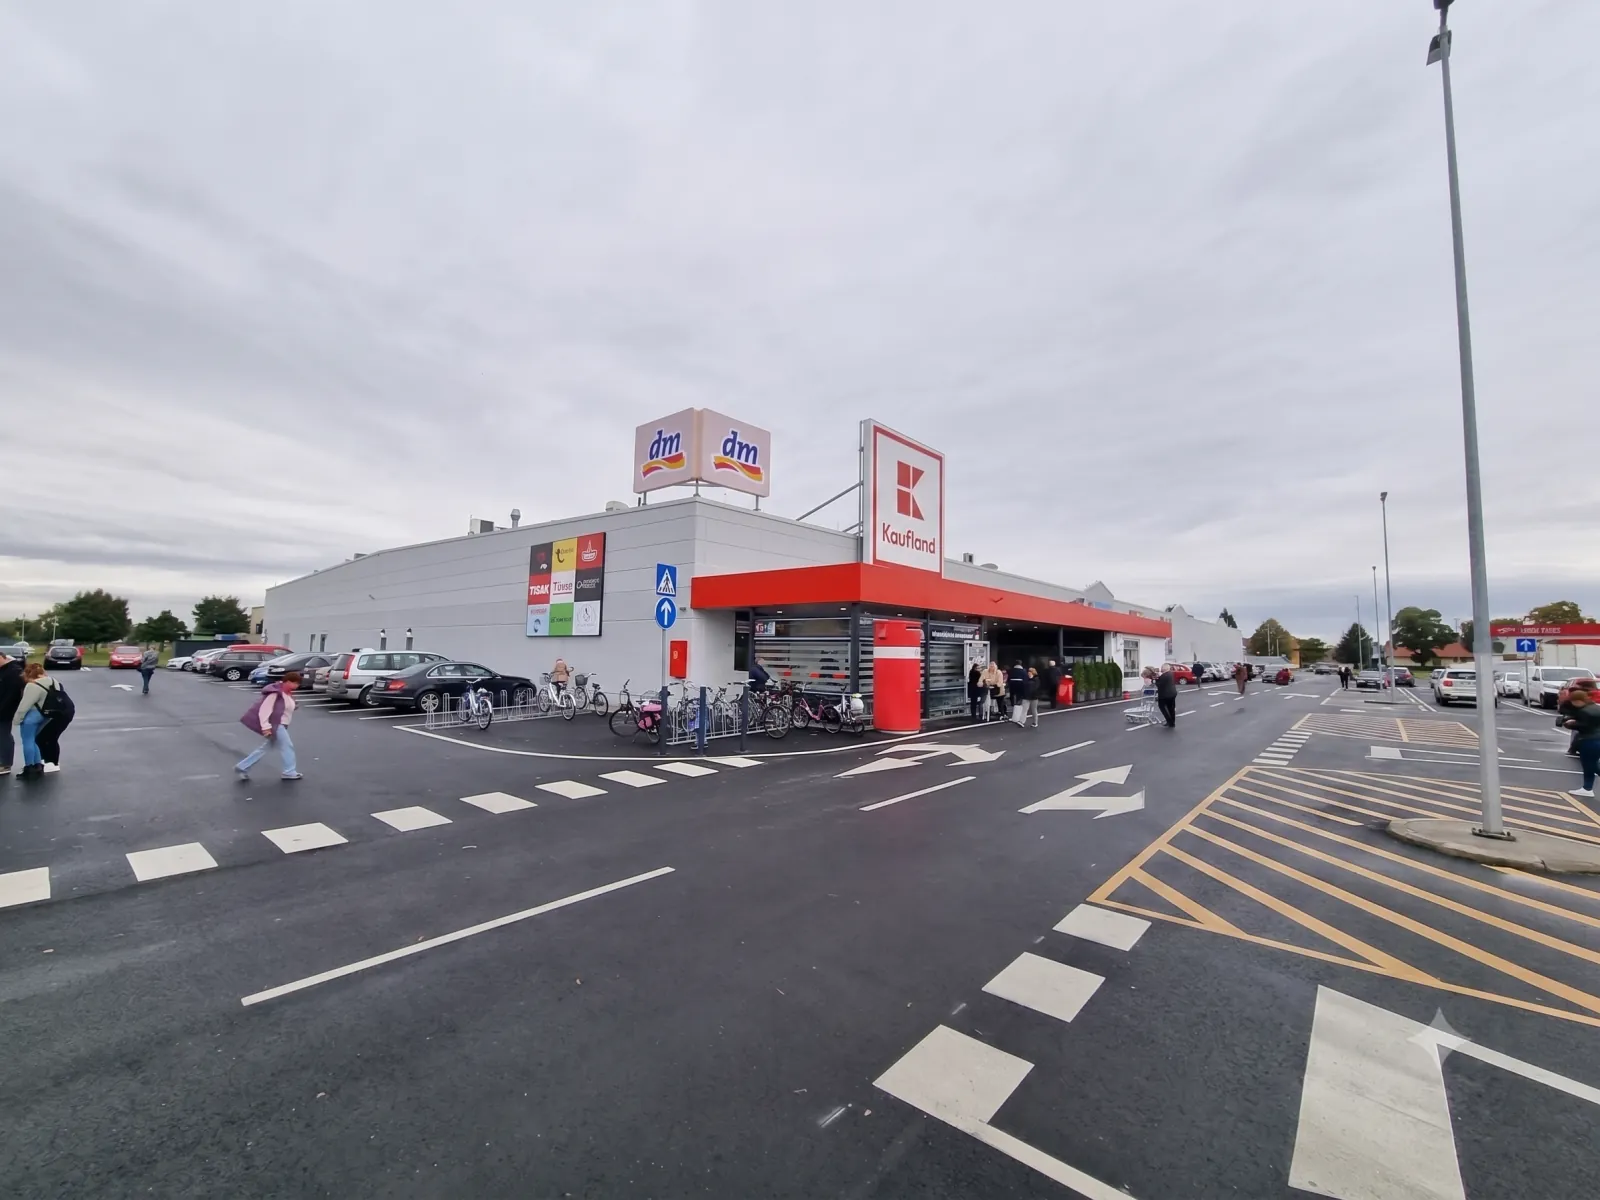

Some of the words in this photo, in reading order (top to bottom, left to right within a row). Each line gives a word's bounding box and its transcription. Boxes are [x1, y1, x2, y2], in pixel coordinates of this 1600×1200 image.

[649, 429, 681, 460] dm
[722, 430, 758, 465] dm
[882, 522, 936, 554] Kaufland
[530, 584, 550, 595] TISAK
